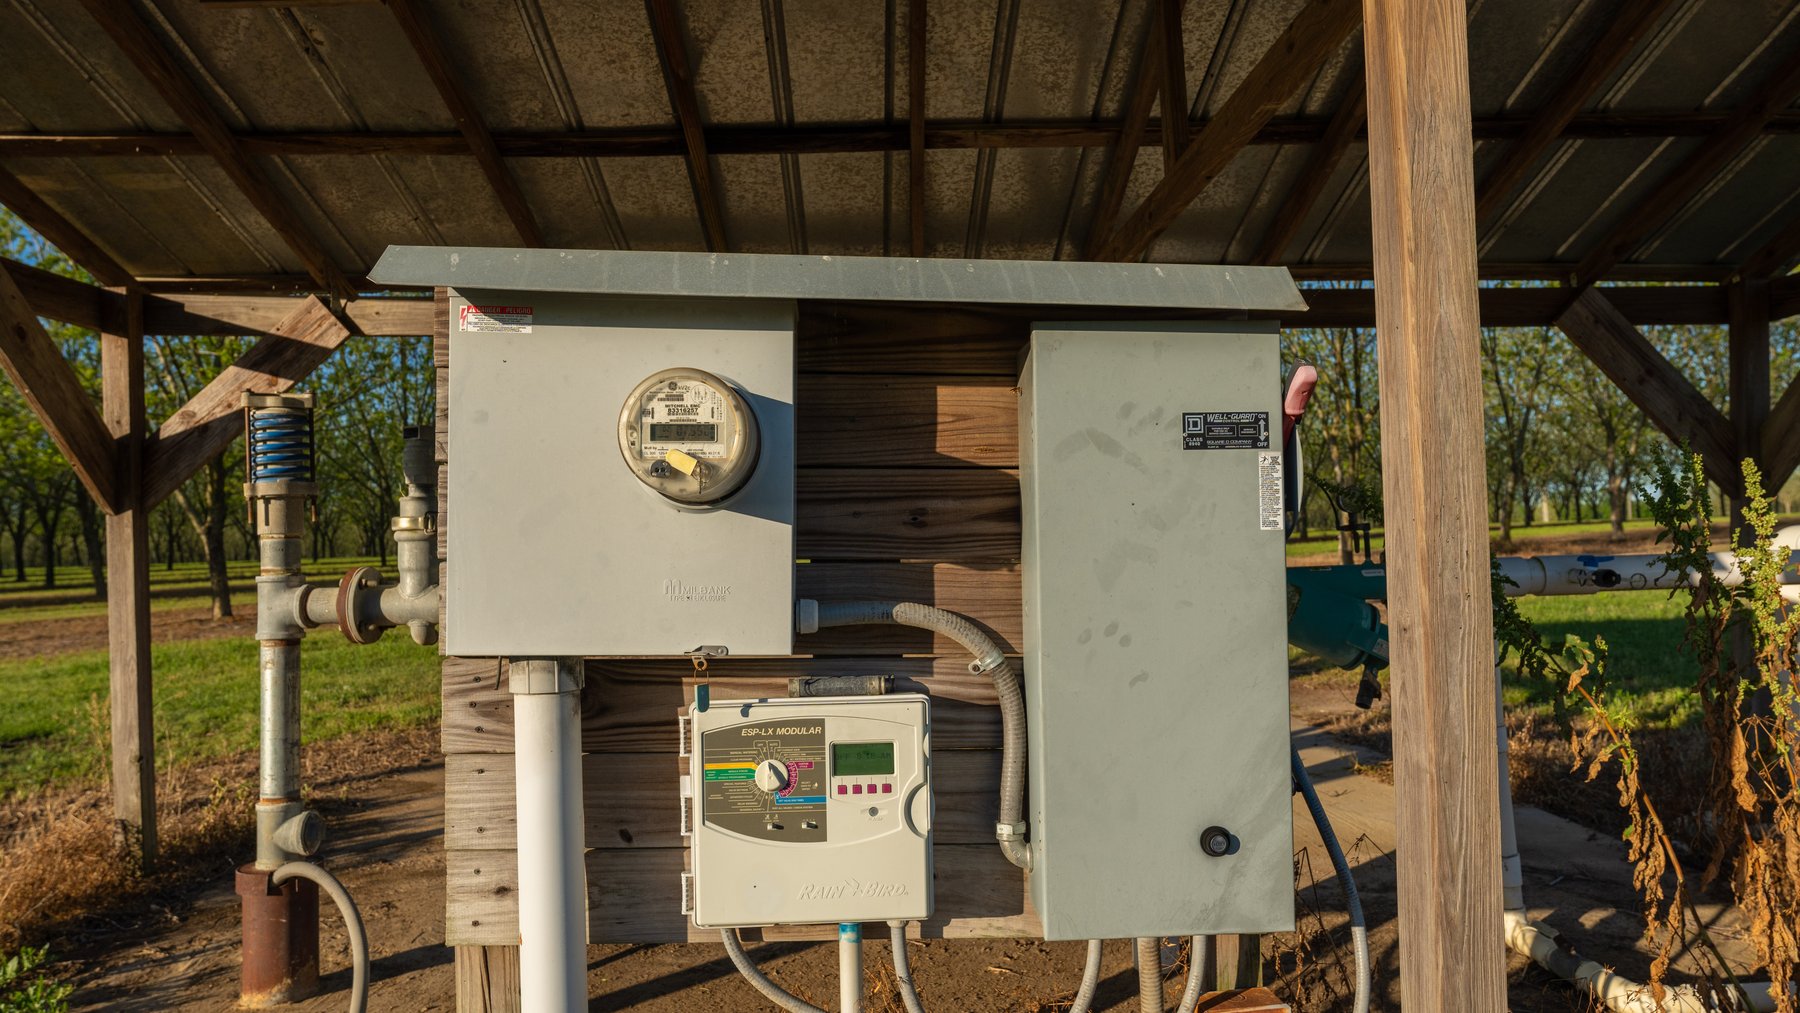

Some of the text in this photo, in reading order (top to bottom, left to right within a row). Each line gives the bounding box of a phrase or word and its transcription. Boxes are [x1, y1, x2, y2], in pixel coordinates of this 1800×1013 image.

[1206, 413, 1256, 423] WELL-GUARD
[682, 585, 732, 595] MILBANK
[741, 726, 822, 737] ESP-LX MODULAR
[797, 880, 907, 900] RAIN BIRD
